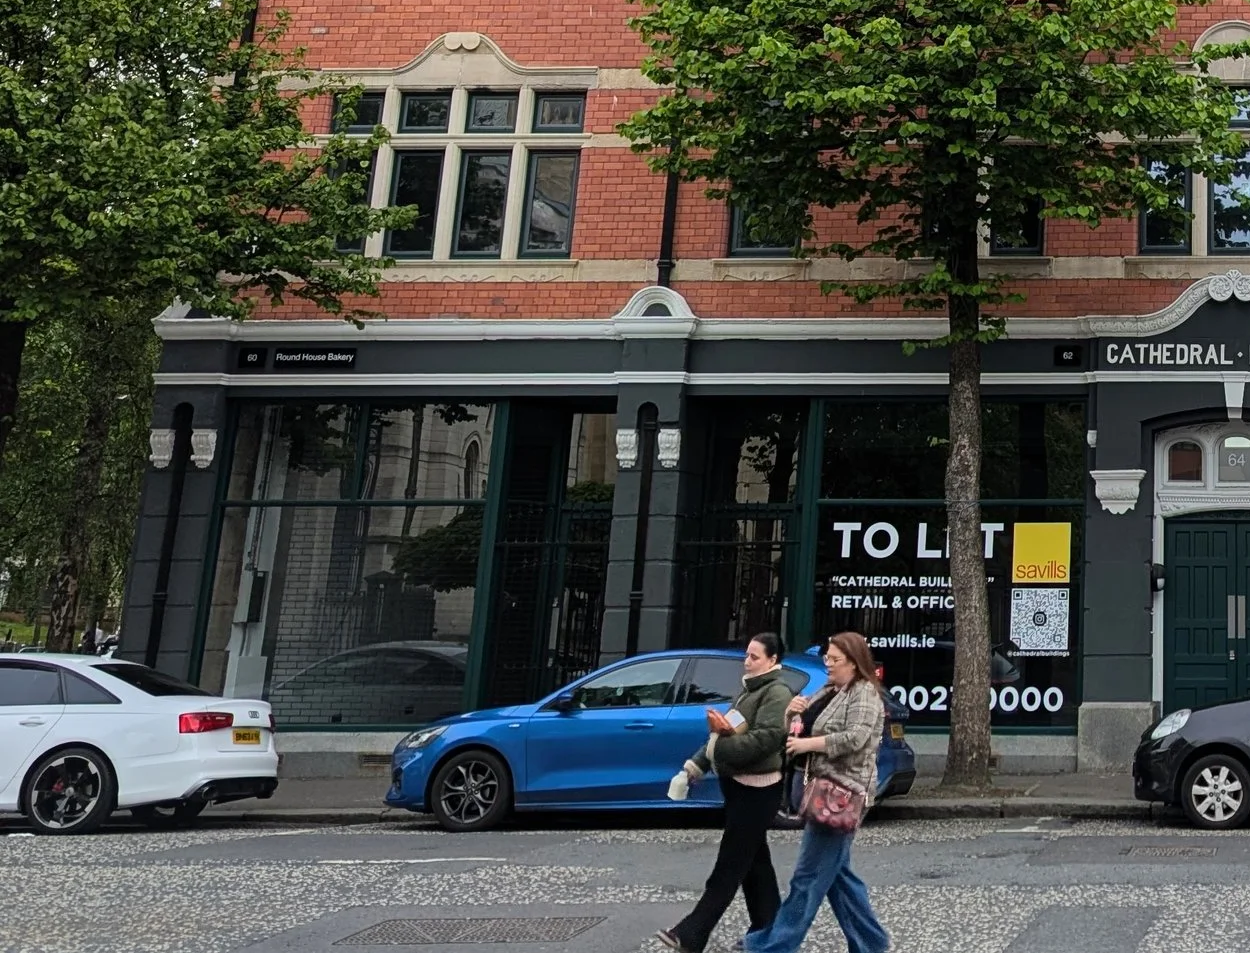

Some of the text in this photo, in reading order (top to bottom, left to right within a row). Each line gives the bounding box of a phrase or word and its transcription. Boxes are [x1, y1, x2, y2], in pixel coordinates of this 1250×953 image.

[247, 353, 257, 362] 60
[276, 352, 354, 363] Round House Bakery
[1063, 351, 1073, 360] 62
[1106, 343, 1233, 365] CATHEDRAL
[1227, 453, 1246, 467] 64
[833, 522, 1005, 559] TO LT
[1015, 560, 1067, 579] savills
[831, 595, 955, 609] RETAIL & OFFIC
